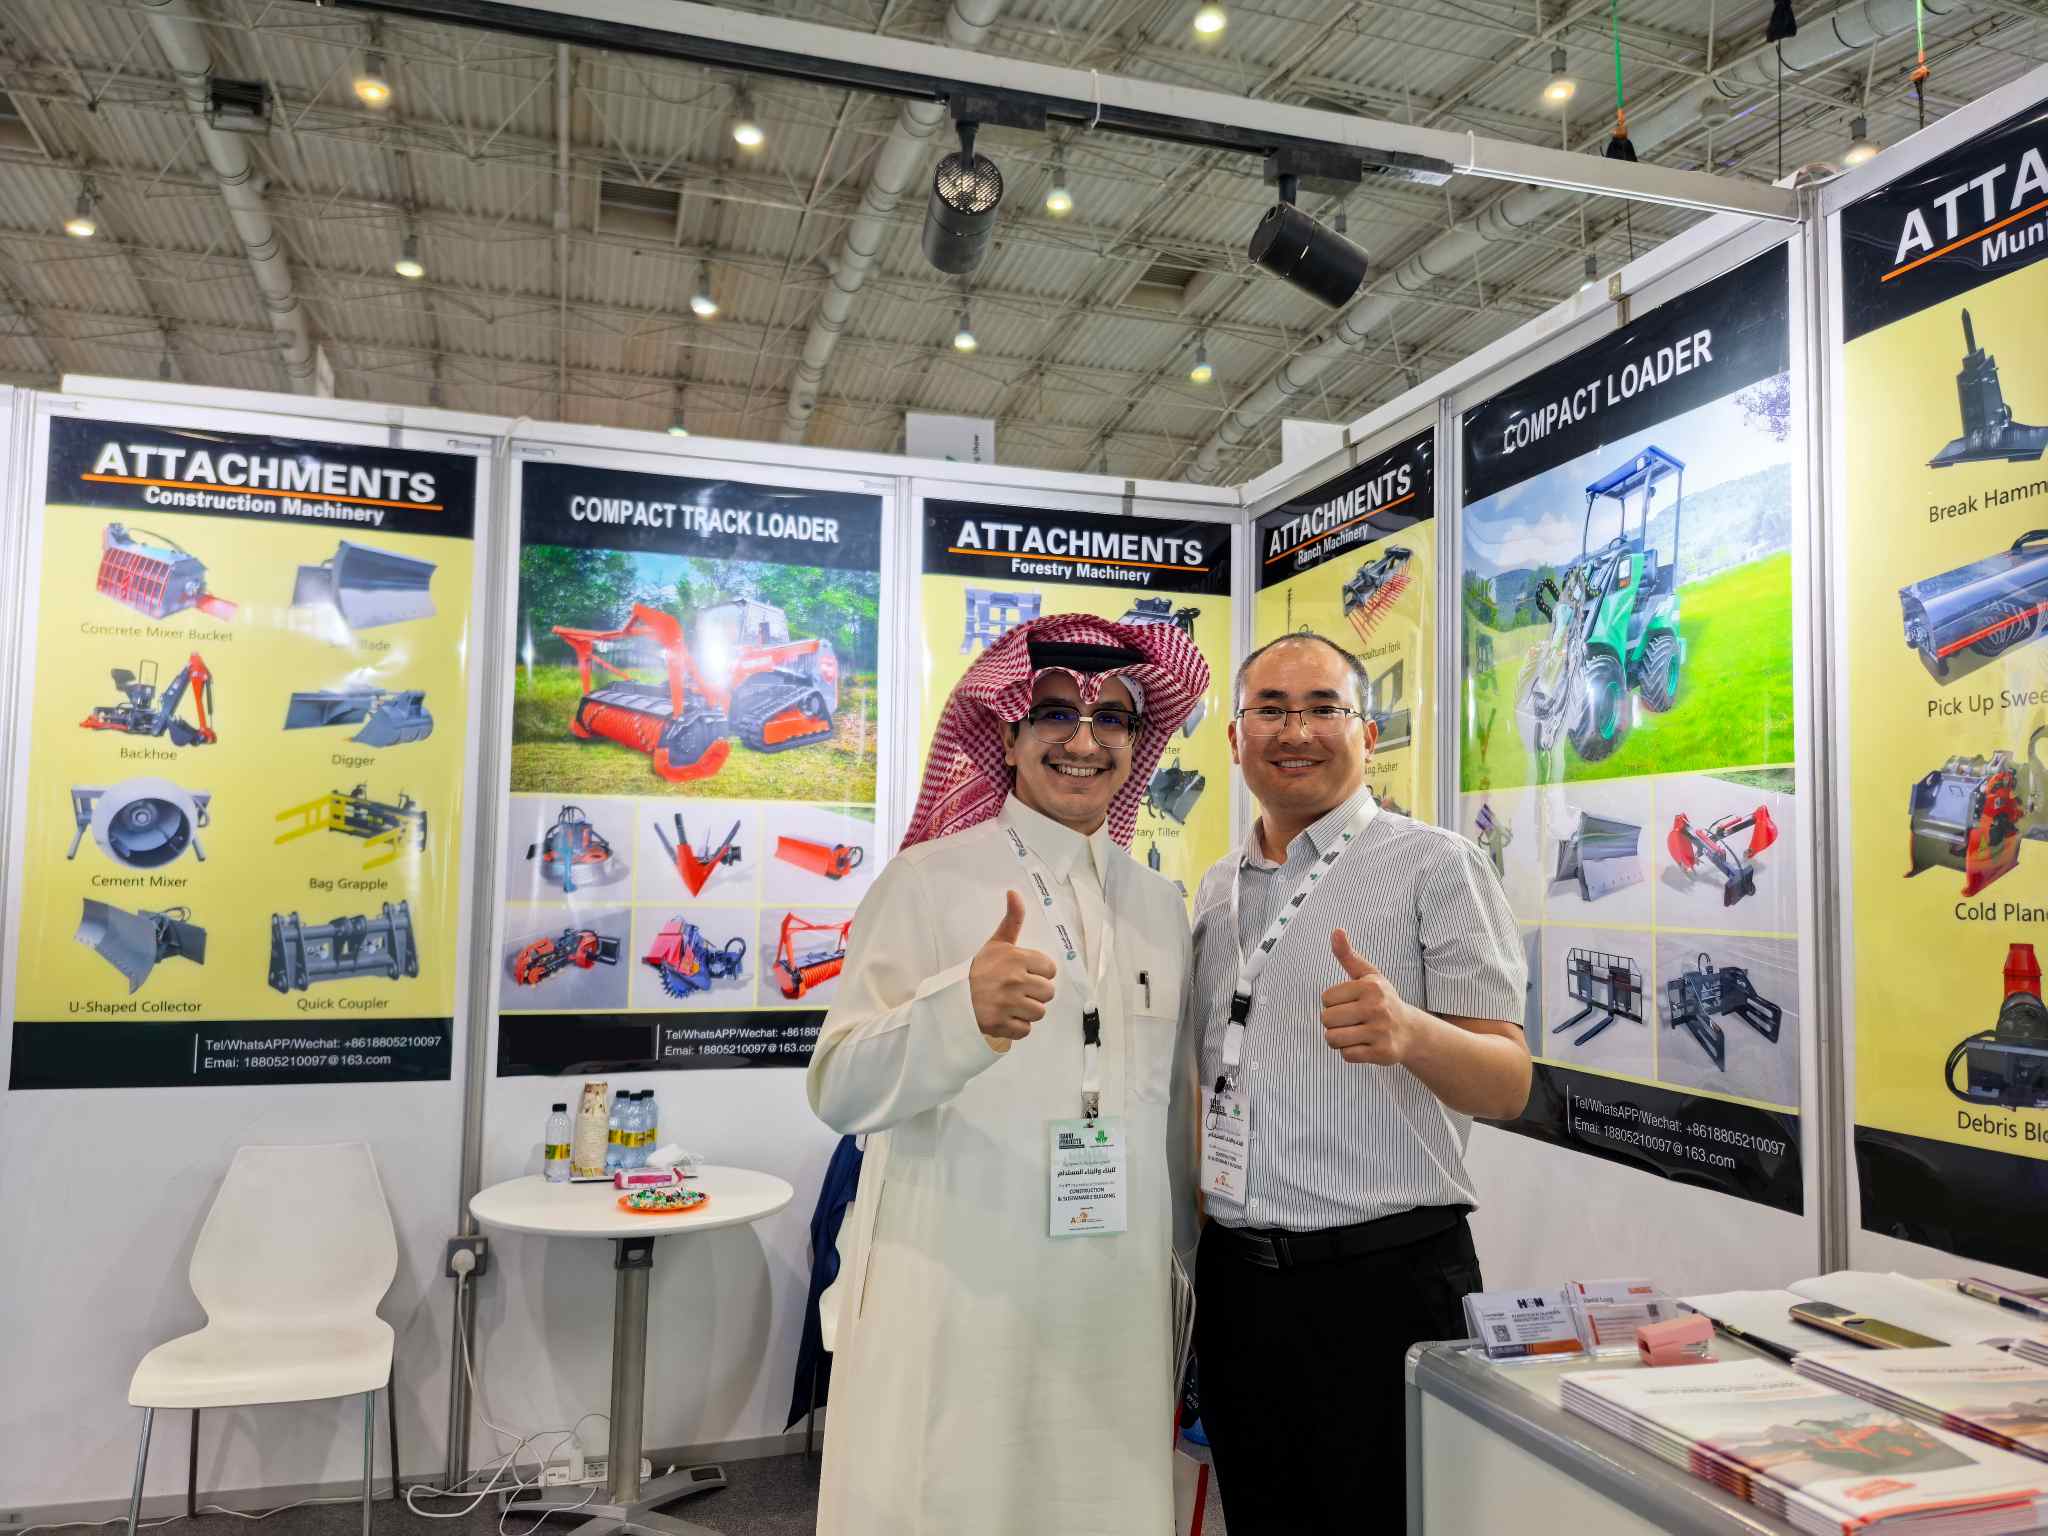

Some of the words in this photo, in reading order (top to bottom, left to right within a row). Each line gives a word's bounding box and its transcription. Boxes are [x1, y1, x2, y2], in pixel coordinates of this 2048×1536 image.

[1895, 147, 2048, 264] ATTA
[1502, 380, 1600, 454] COMPACT
[1607, 329, 1713, 406] LOADER
[94, 443, 437, 503] ATTACHMENTS
[144, 486, 276, 514] Construction
[281, 498, 385, 526] Machinery
[1269, 463, 1411, 557] ATTACHMENTS
[1929, 496, 1978, 523] Break
[1984, 479, 2048, 509] Hamm
[571, 496, 677, 528] COMPACT
[681, 505, 752, 535] TRACK
[756, 512, 839, 543] LOADER
[956, 520, 1203, 566] ATTACHMENTS
[1298, 544, 1321, 565] Ranch
[1323, 524, 1368, 554] Machinery
[1011, 558, 1072, 580] Forestry
[1076, 563, 1150, 585] Machinery
[80, 622, 140, 638] Concrete
[145, 626, 185, 640] Mixer
[188, 629, 234, 643] Bucket
[1928, 697, 1962, 717] Pick
[1969, 693, 1994, 716] Up
[120, 748, 178, 762] Backhoe
[331, 755, 376, 769] Digger
[91, 874, 145, 888] Cement
[149, 875, 189, 888] Mixer
[309, 878, 334, 892] Bag
[338, 878, 389, 892] Grapple
[1955, 903, 1997, 921] Cold
[2004, 902, 2048, 922] Plan
[69, 1000, 138, 1015] U-Shaped
[140, 1000, 203, 1013] Collector
[296, 997, 336, 1011] Quick
[339, 997, 390, 1012] Coupler
[1957, 1111, 2018, 1139] Debris
